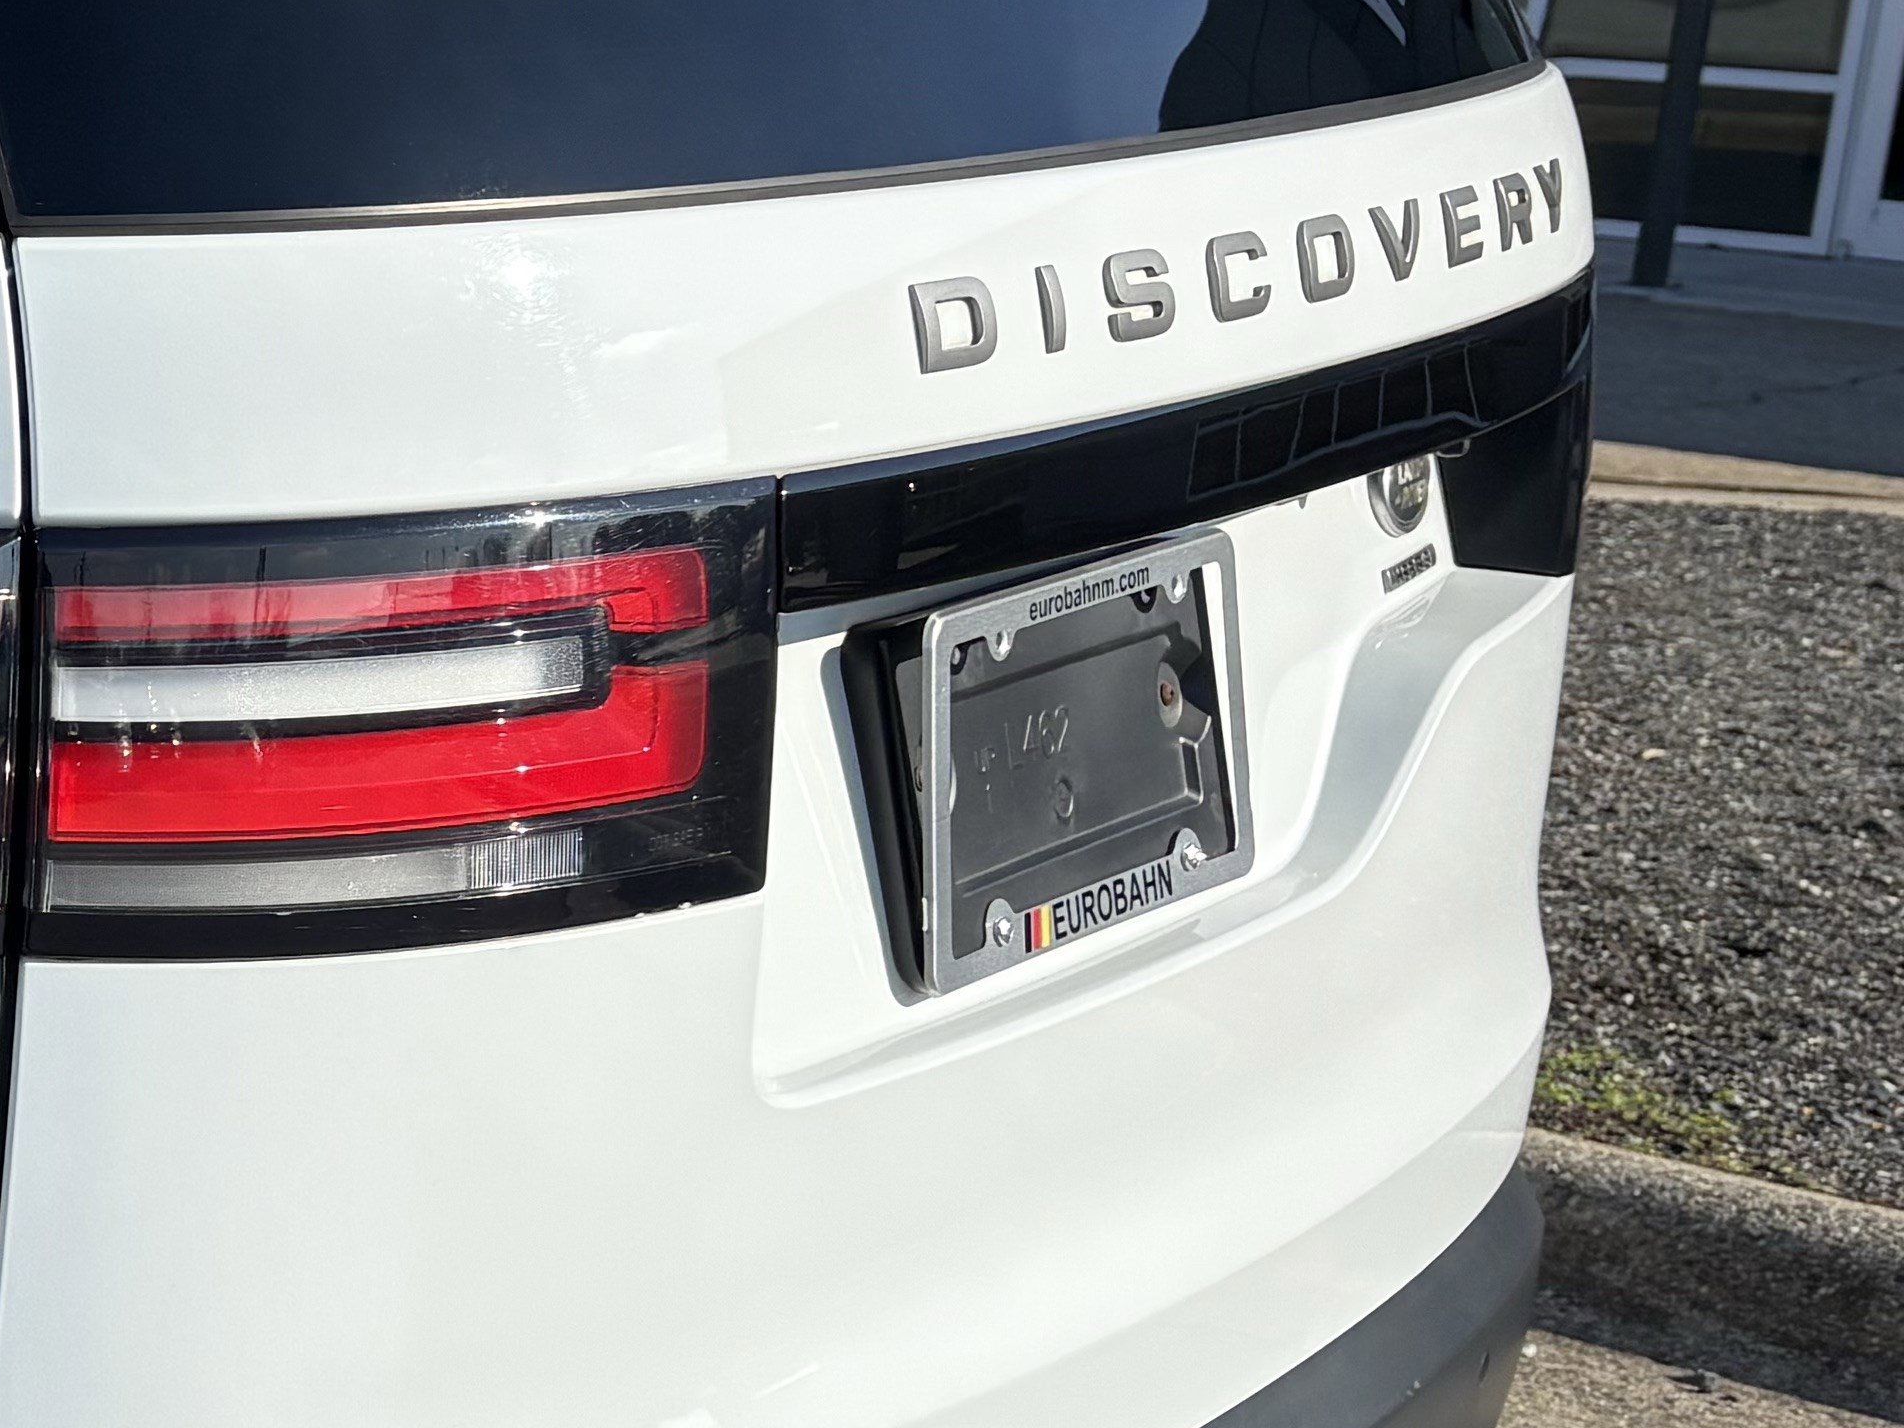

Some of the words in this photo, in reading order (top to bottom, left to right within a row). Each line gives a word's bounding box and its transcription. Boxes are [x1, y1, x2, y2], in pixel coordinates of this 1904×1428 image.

[908, 158, 1564, 374] DISCOVERY
[1029, 566, 1150, 621] eurobahnm.com
[1052, 859, 1173, 940] EUROBAHN
